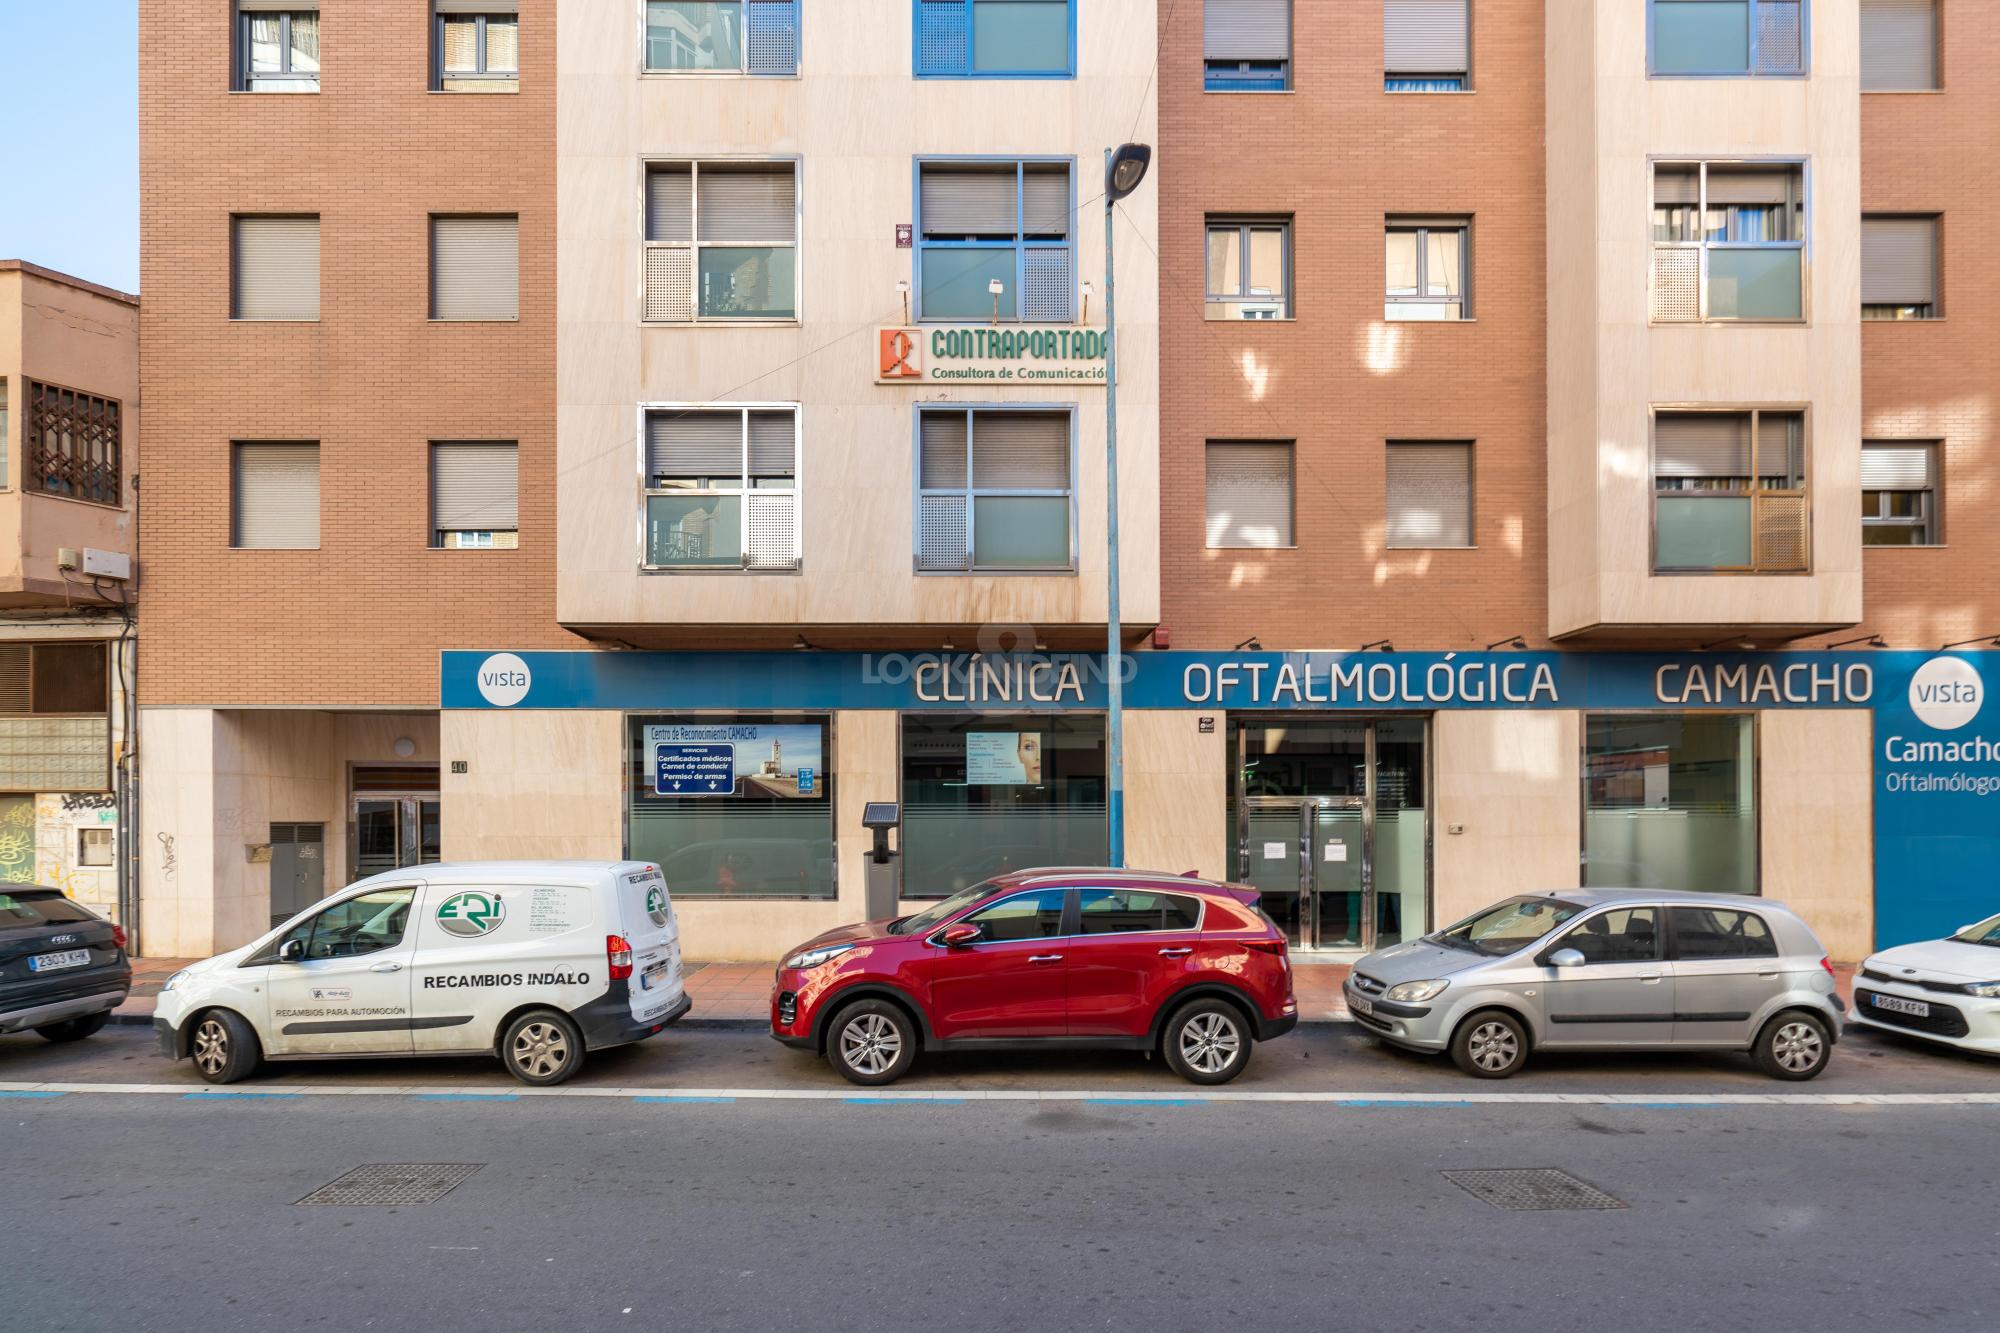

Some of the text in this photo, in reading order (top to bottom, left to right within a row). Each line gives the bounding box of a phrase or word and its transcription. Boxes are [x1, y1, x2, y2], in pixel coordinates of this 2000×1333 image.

[932, 366, 1108, 379] Consultora de Comunicació
[483, 670, 526, 687] vista
[916, 652, 1874, 703] CLÍNICA OFTALMOLÓGICA CAMACHO
[1917, 681, 1976, 703] vista
[651, 727, 757, 740] Centro de Reconocimiento CAMACHO
[39, 950, 87, 967] 2303 KHK
[424, 972, 590, 988] RECAMBIOS INDALO
[276, 1006, 406, 1017] RECAMBIOS PARA AUTOMOCIÓN
